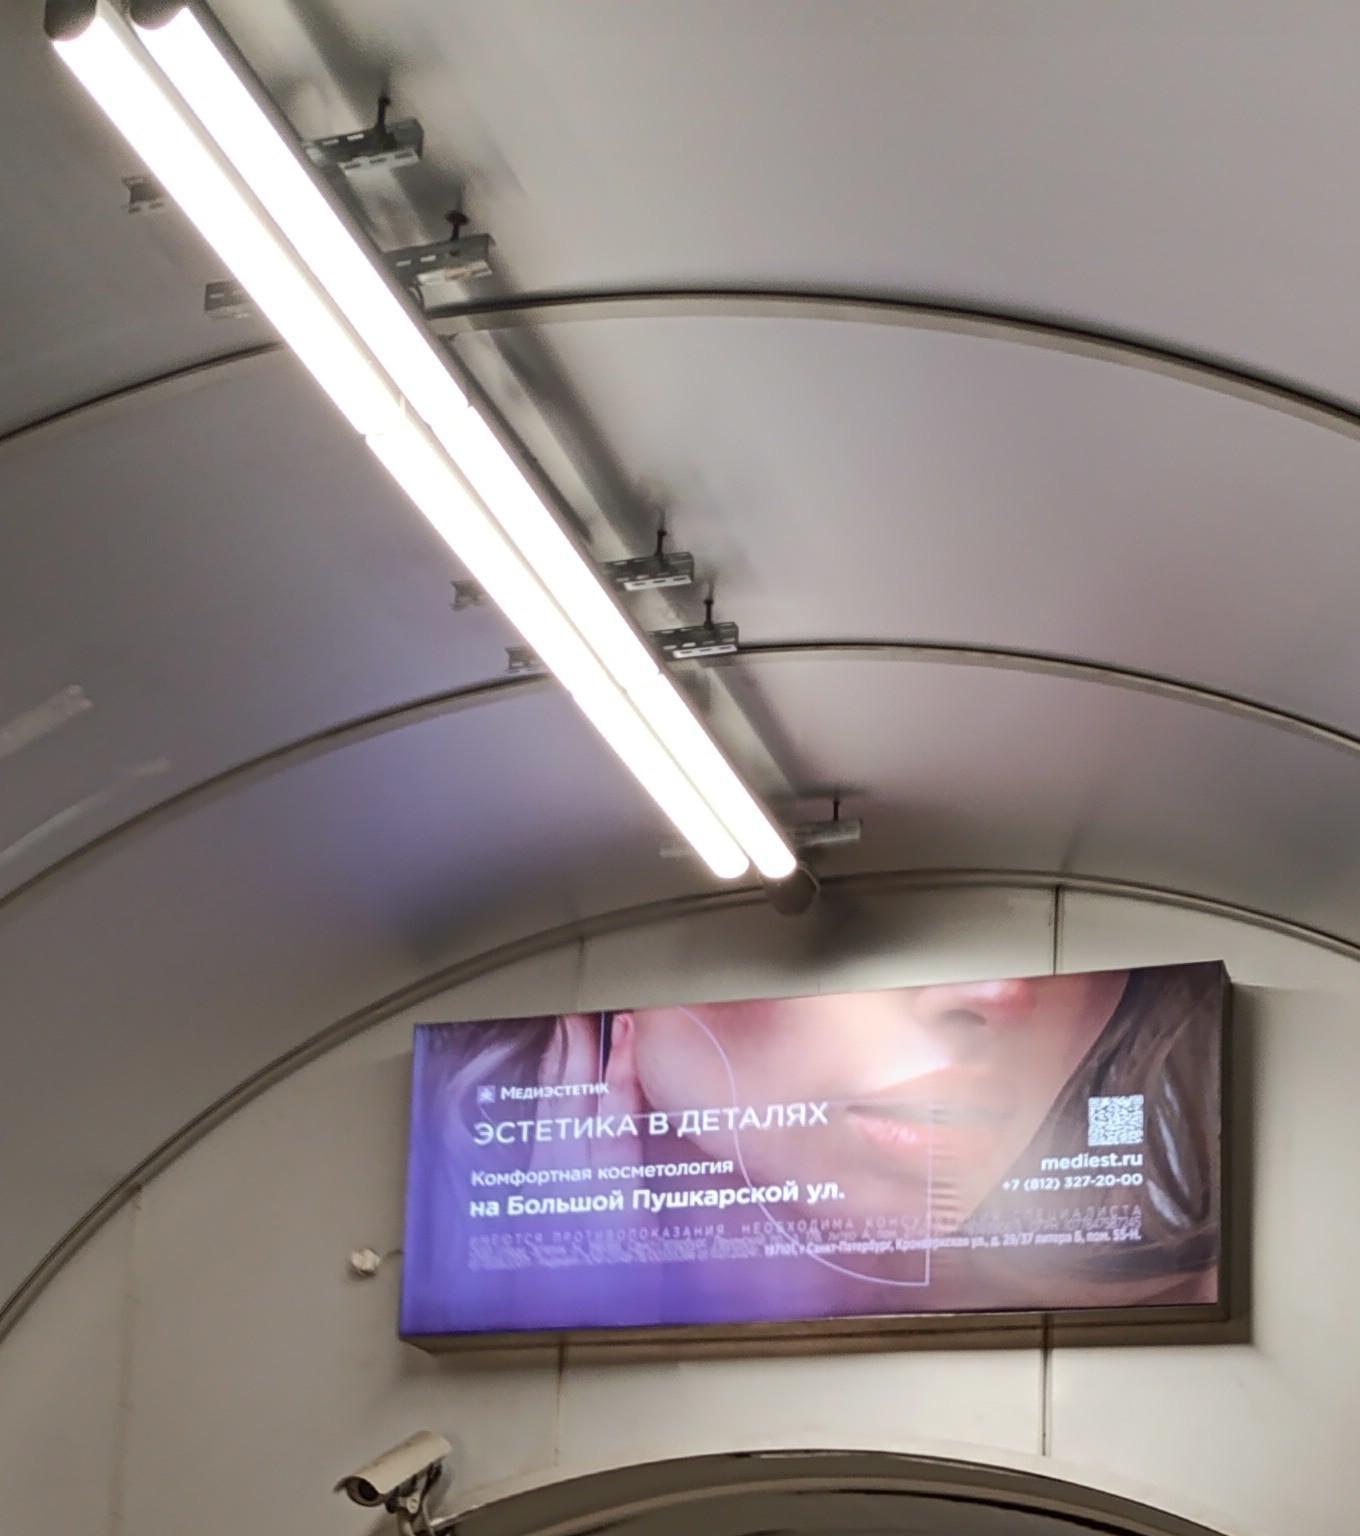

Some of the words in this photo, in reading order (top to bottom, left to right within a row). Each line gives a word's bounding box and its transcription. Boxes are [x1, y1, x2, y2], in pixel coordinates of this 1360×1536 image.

[473, 1114, 638, 1145] ЭСТЕТИКА
[649, 1112, 669, 1135] В
[677, 1102, 828, 1138] ДЕТАЛЯХ
[471, 1168, 592, 1187] Комфортная
[598, 1160, 734, 1180] косметология
[1041, 1152, 1144, 1171] mediest.ru
[1002, 1178, 1020, 1191] +7
[1023, 1176, 1061, 1191] (812)
[1064, 1173, 1144, 1189] 327-20-00
[470, 1200, 500, 1218] на
[506, 1188, 624, 1216] Большой
[632, 1180, 800, 1213] Пушкарской
[806, 1182, 846, 1204] ул.
